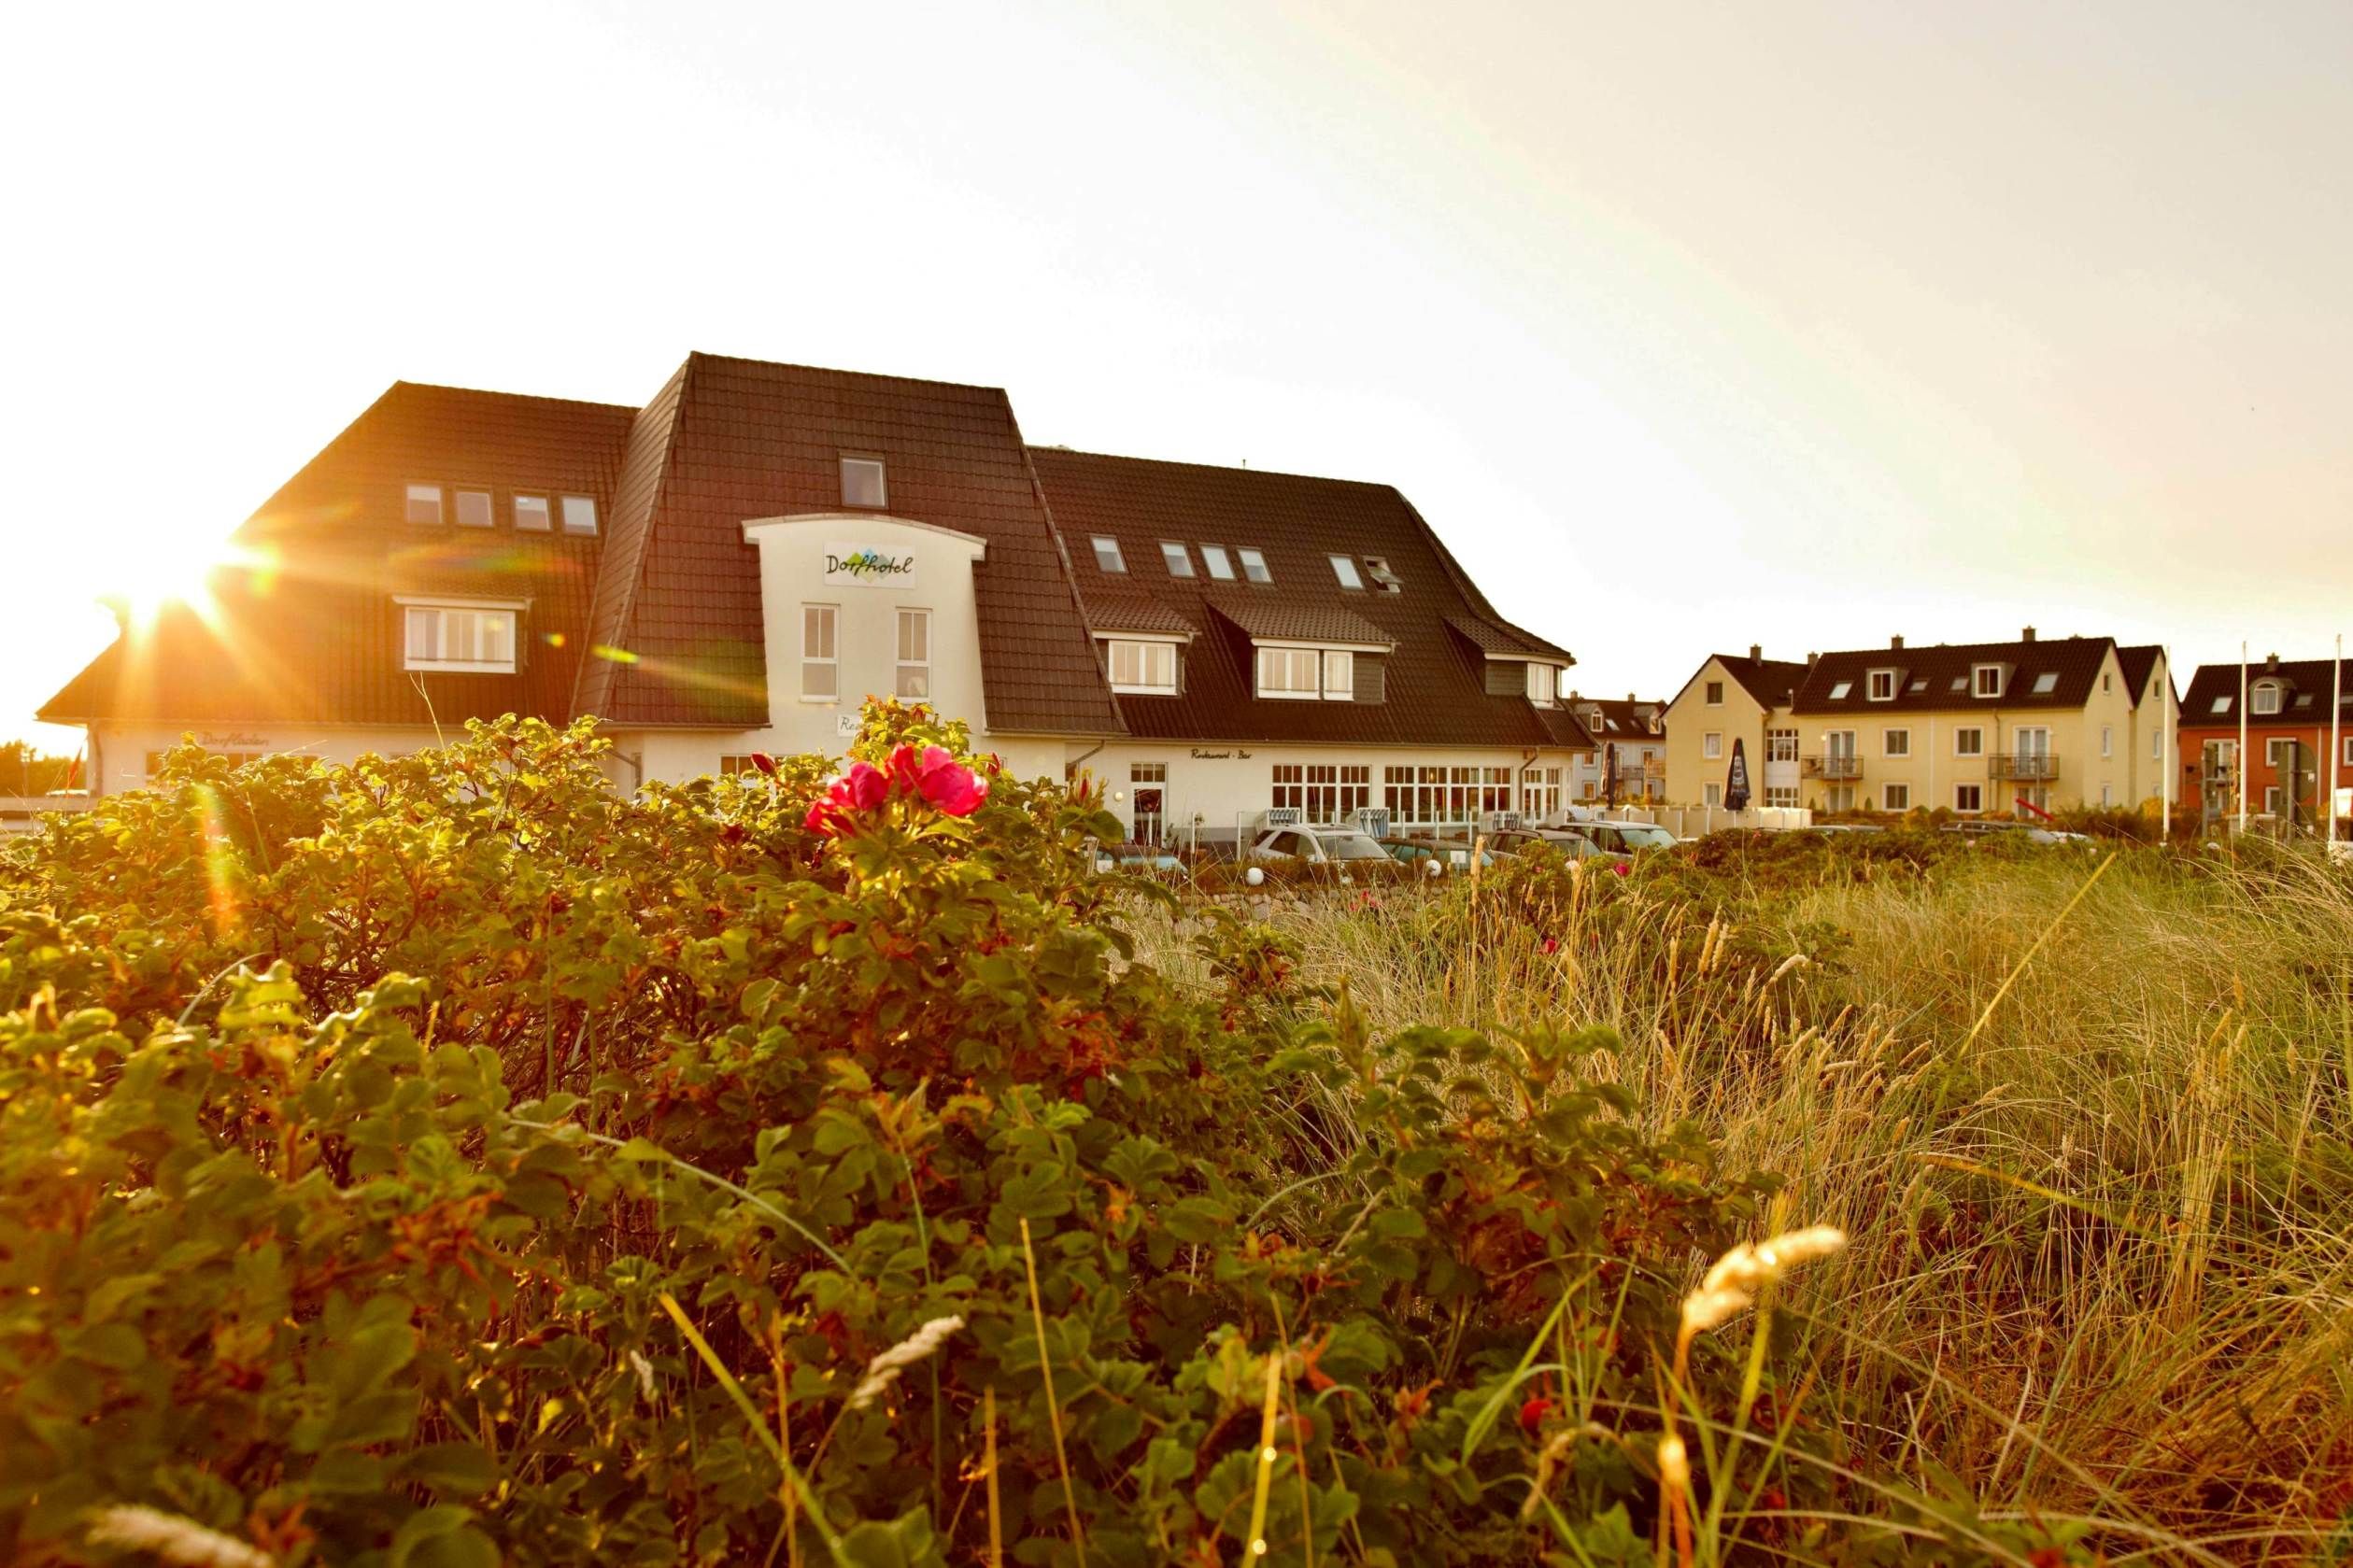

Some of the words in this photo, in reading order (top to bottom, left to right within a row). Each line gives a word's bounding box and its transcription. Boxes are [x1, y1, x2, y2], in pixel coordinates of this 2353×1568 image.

[826, 554, 914, 576] Dorfhotel
[1191, 748, 1230, 759] Restaurant
[1238, 749, 1252, 759] Bar
